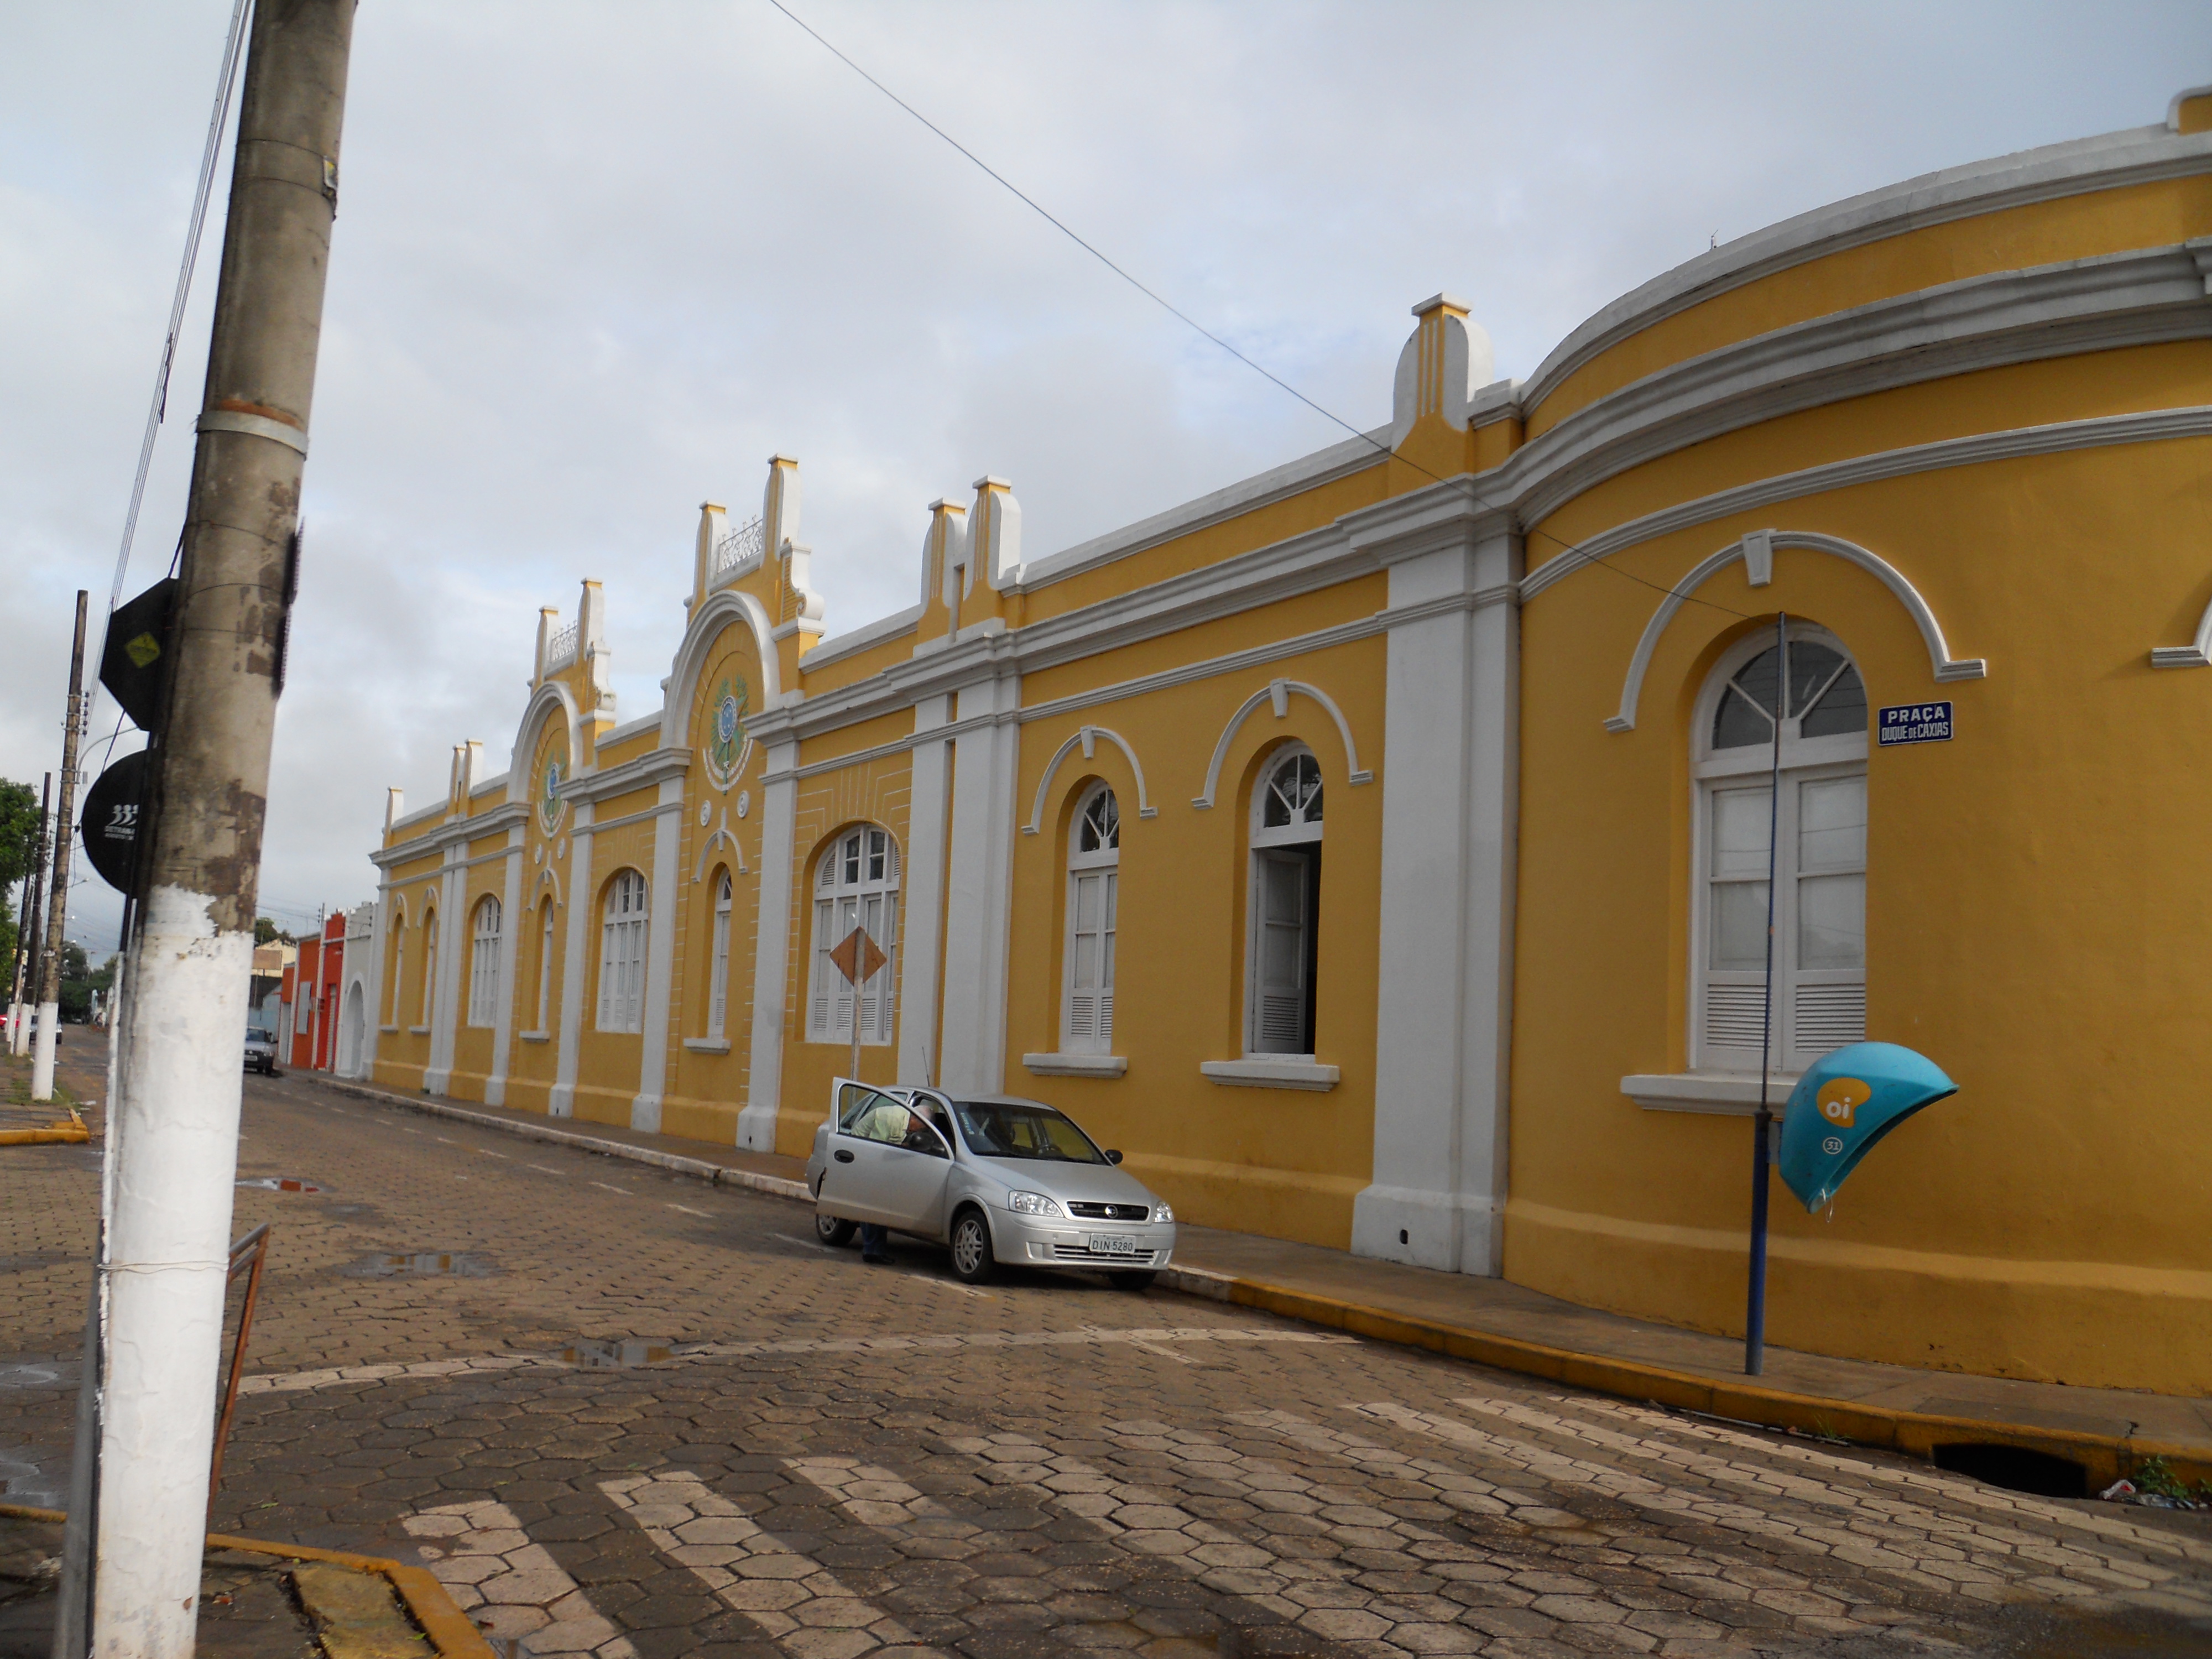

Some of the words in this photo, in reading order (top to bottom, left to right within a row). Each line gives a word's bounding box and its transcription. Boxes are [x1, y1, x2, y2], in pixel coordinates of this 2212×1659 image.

[1888, 706, 1945, 723] PRAÇA
[1882, 726, 1908, 741] DUQUE
[1908, 727, 1917, 739] DE
[1917, 722, 1949, 738] CAXIAS
[1826, 1097, 1850, 1119] oi
[1827, 1141, 1839, 1150] 31
[1113, 1241, 1133, 1251] 5280
